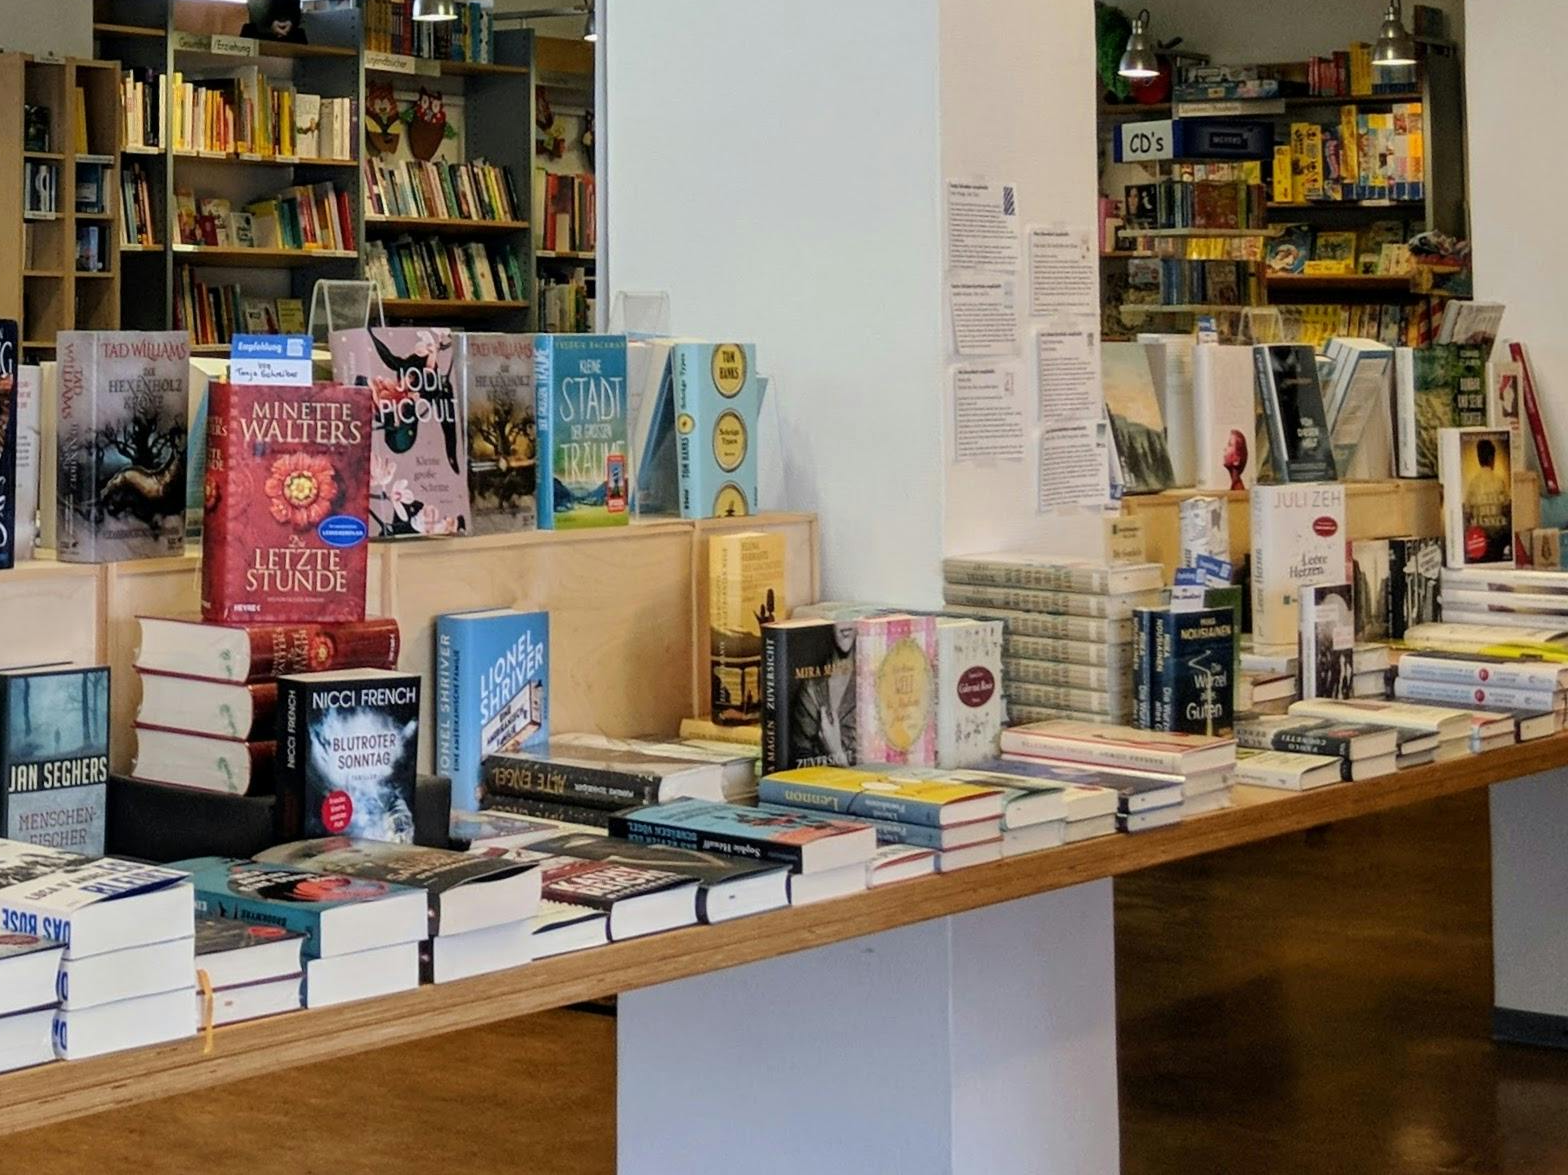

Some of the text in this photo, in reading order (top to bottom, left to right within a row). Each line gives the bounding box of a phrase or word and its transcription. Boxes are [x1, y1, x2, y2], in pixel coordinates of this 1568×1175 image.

[1130, 131, 1164, 153] CD's
[102, 339, 187, 362] TAD WILLIAMS
[238, 339, 282, 354] Empfehlung
[396, 367, 442, 392] JODI
[252, 401, 352, 420] MINETTE
[560, 376, 623, 422] STADT
[380, 398, 457, 424] PICOULT
[240, 419, 362, 444] WALTERS
[1274, 490, 1341, 508] JULI ZEH
[254, 548, 341, 571] LETZTE
[246, 570, 347, 593] STUNDE
[440, 634, 451, 712] SHRIVER
[481, 630, 534, 699] LIONEL
[794, 666, 822, 679] MIRA
[480, 642, 544, 724] SHRIVER
[312, 687, 417, 710] NICCI FRENCH
[766, 638, 776, 762] MAGEN ZUVERSICHT
[287, 690, 297, 769] NICCI FRENCH
[333, 733, 396, 752] BLUTROTER
[338, 752, 391, 770] SONNTAG
[8, 756, 108, 793] JAN SEGHERS
[492, 767, 533, 793] ENGEL
[537, 773, 567, 794] ALTE
[785, 789, 838, 812] Lennon
[18, 805, 97, 832] MENSCHEN-
[732, 844, 761, 858] Sophie
[43, 916, 71, 950] DAS
